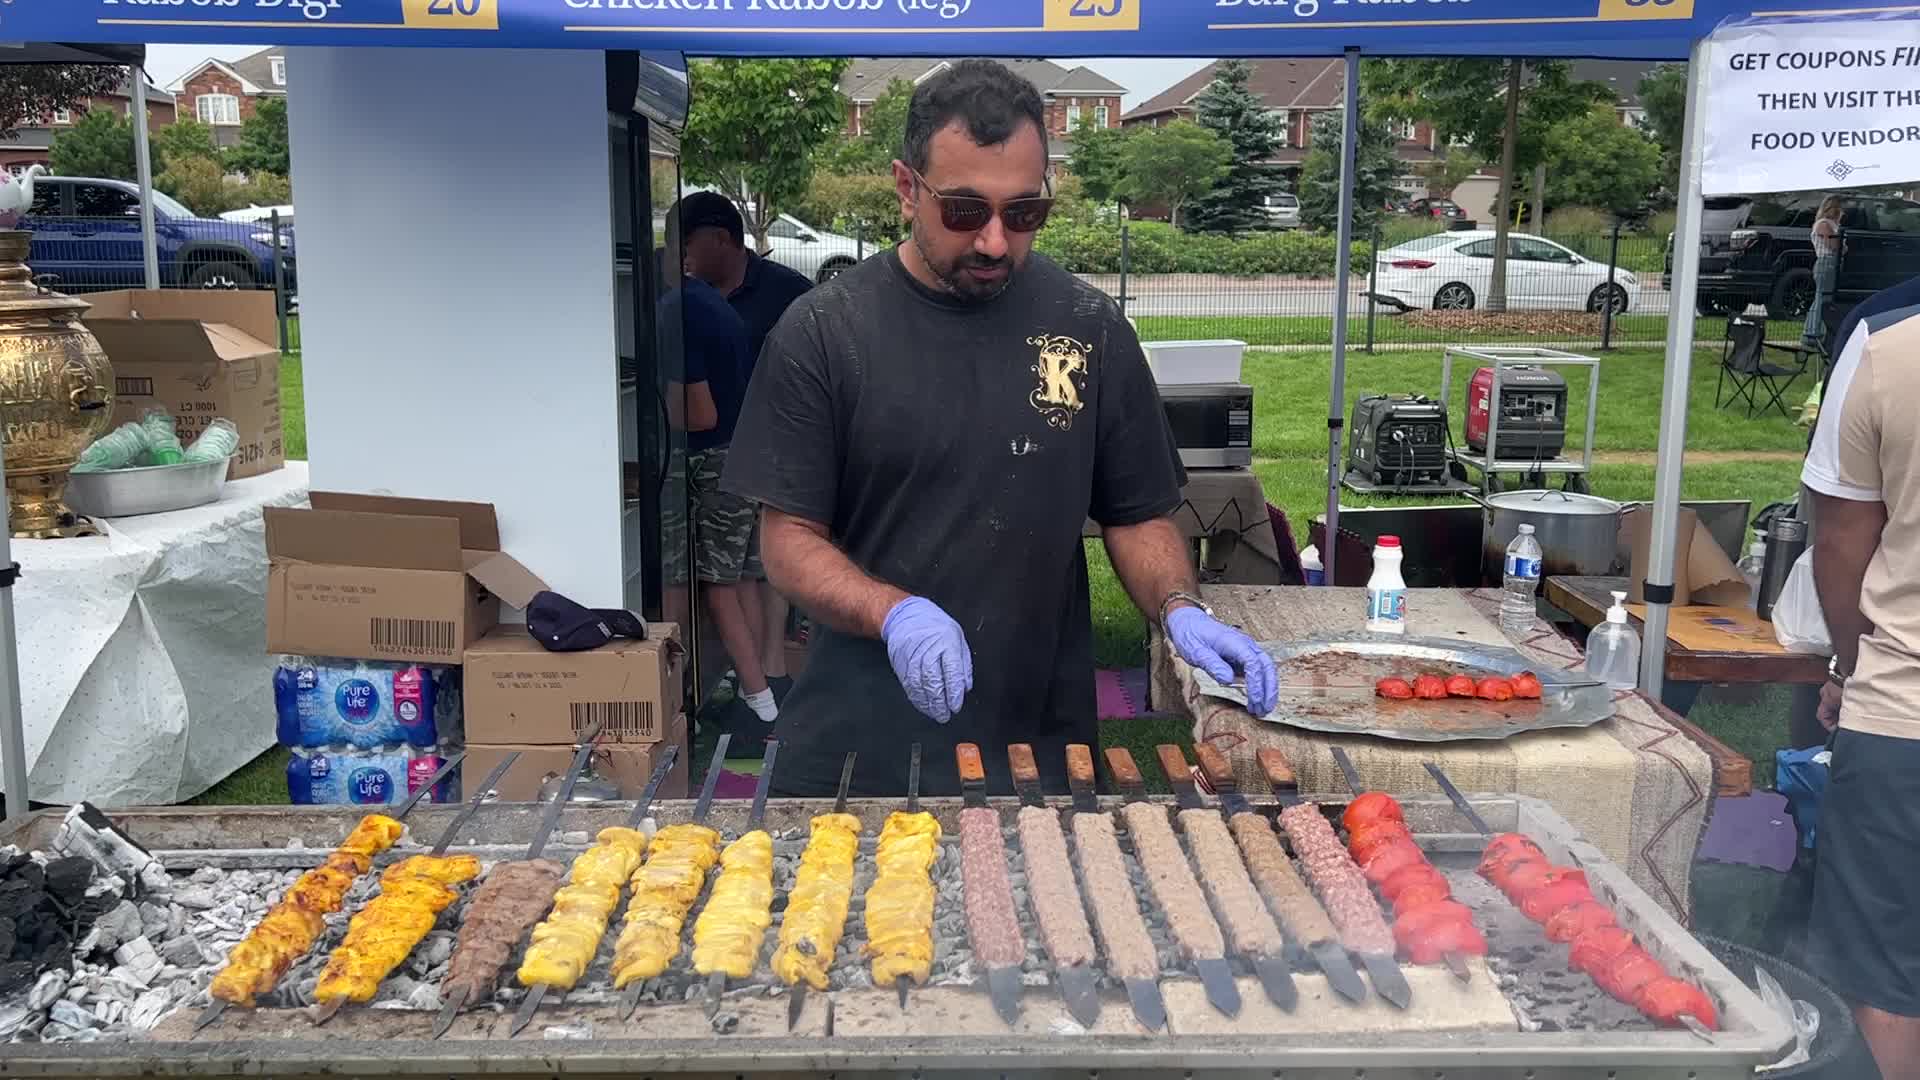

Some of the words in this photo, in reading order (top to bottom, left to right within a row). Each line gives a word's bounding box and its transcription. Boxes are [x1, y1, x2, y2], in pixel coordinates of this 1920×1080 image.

[1730, 53, 1771, 70] GET
[1776, 50, 1886, 69] COUPONS
[1758, 92, 1817, 110] THEN
[1824, 91, 1878, 108] VISIT
[1751, 132, 1815, 150] FOOD
[297, 670, 313, 680] 24
[343, 685, 370, 696] Pure
[347, 698, 367, 709] Life
[311, 758, 327, 768] 24
[355, 772, 384, 784] Pure
[360, 783, 382, 795] Life
